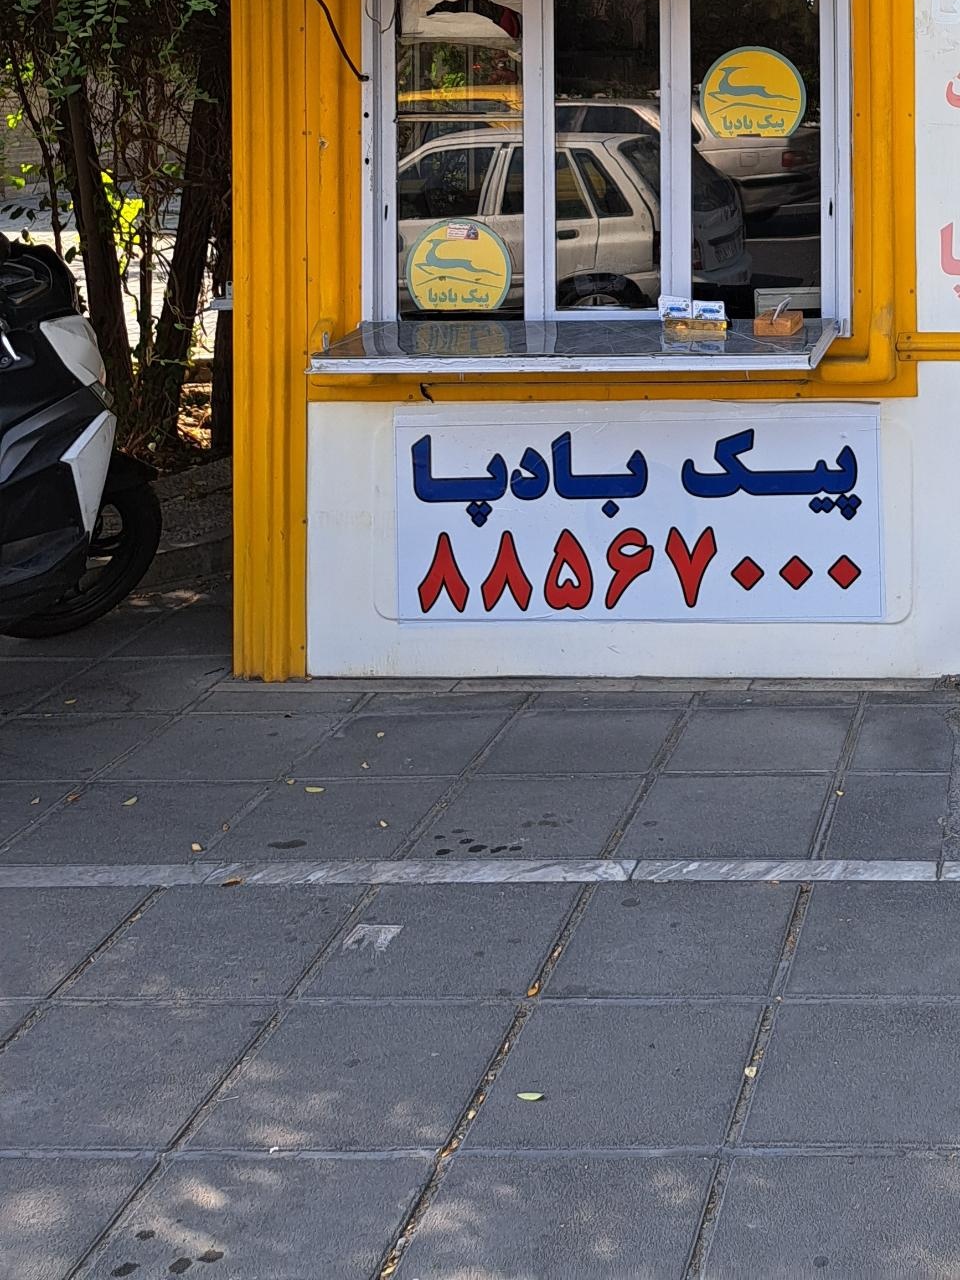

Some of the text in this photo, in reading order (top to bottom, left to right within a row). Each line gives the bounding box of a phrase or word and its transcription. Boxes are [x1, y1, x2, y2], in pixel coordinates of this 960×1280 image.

[757, 114, 785, 133] پیک
[461, 288, 489, 308] پیک
[681, 428, 861, 520] پیک
[418, 526, 861, 612] ۸۸۵۶۷۰۰۰
